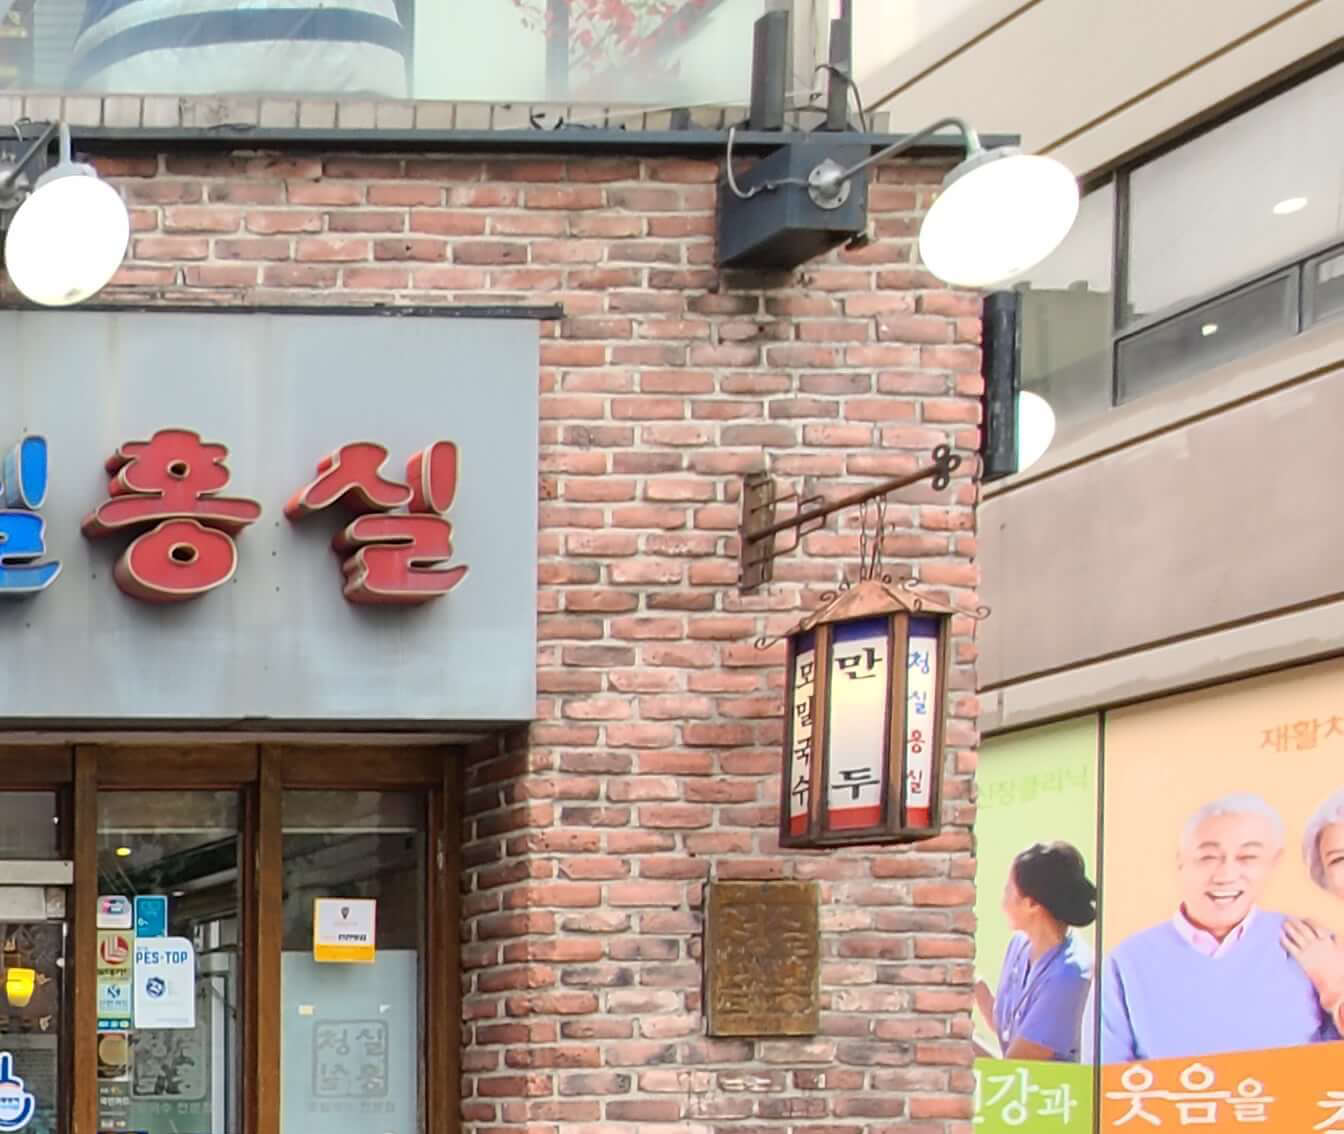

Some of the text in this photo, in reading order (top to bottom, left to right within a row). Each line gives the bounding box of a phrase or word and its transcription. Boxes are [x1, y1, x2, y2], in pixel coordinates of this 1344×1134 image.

[793, 661, 814, 807] 모밀국수
[831, 647, 883, 800] 만두
[907, 651, 931, 795] 청실홍실
[1105, 1063, 1275, 1127] 웃음을
